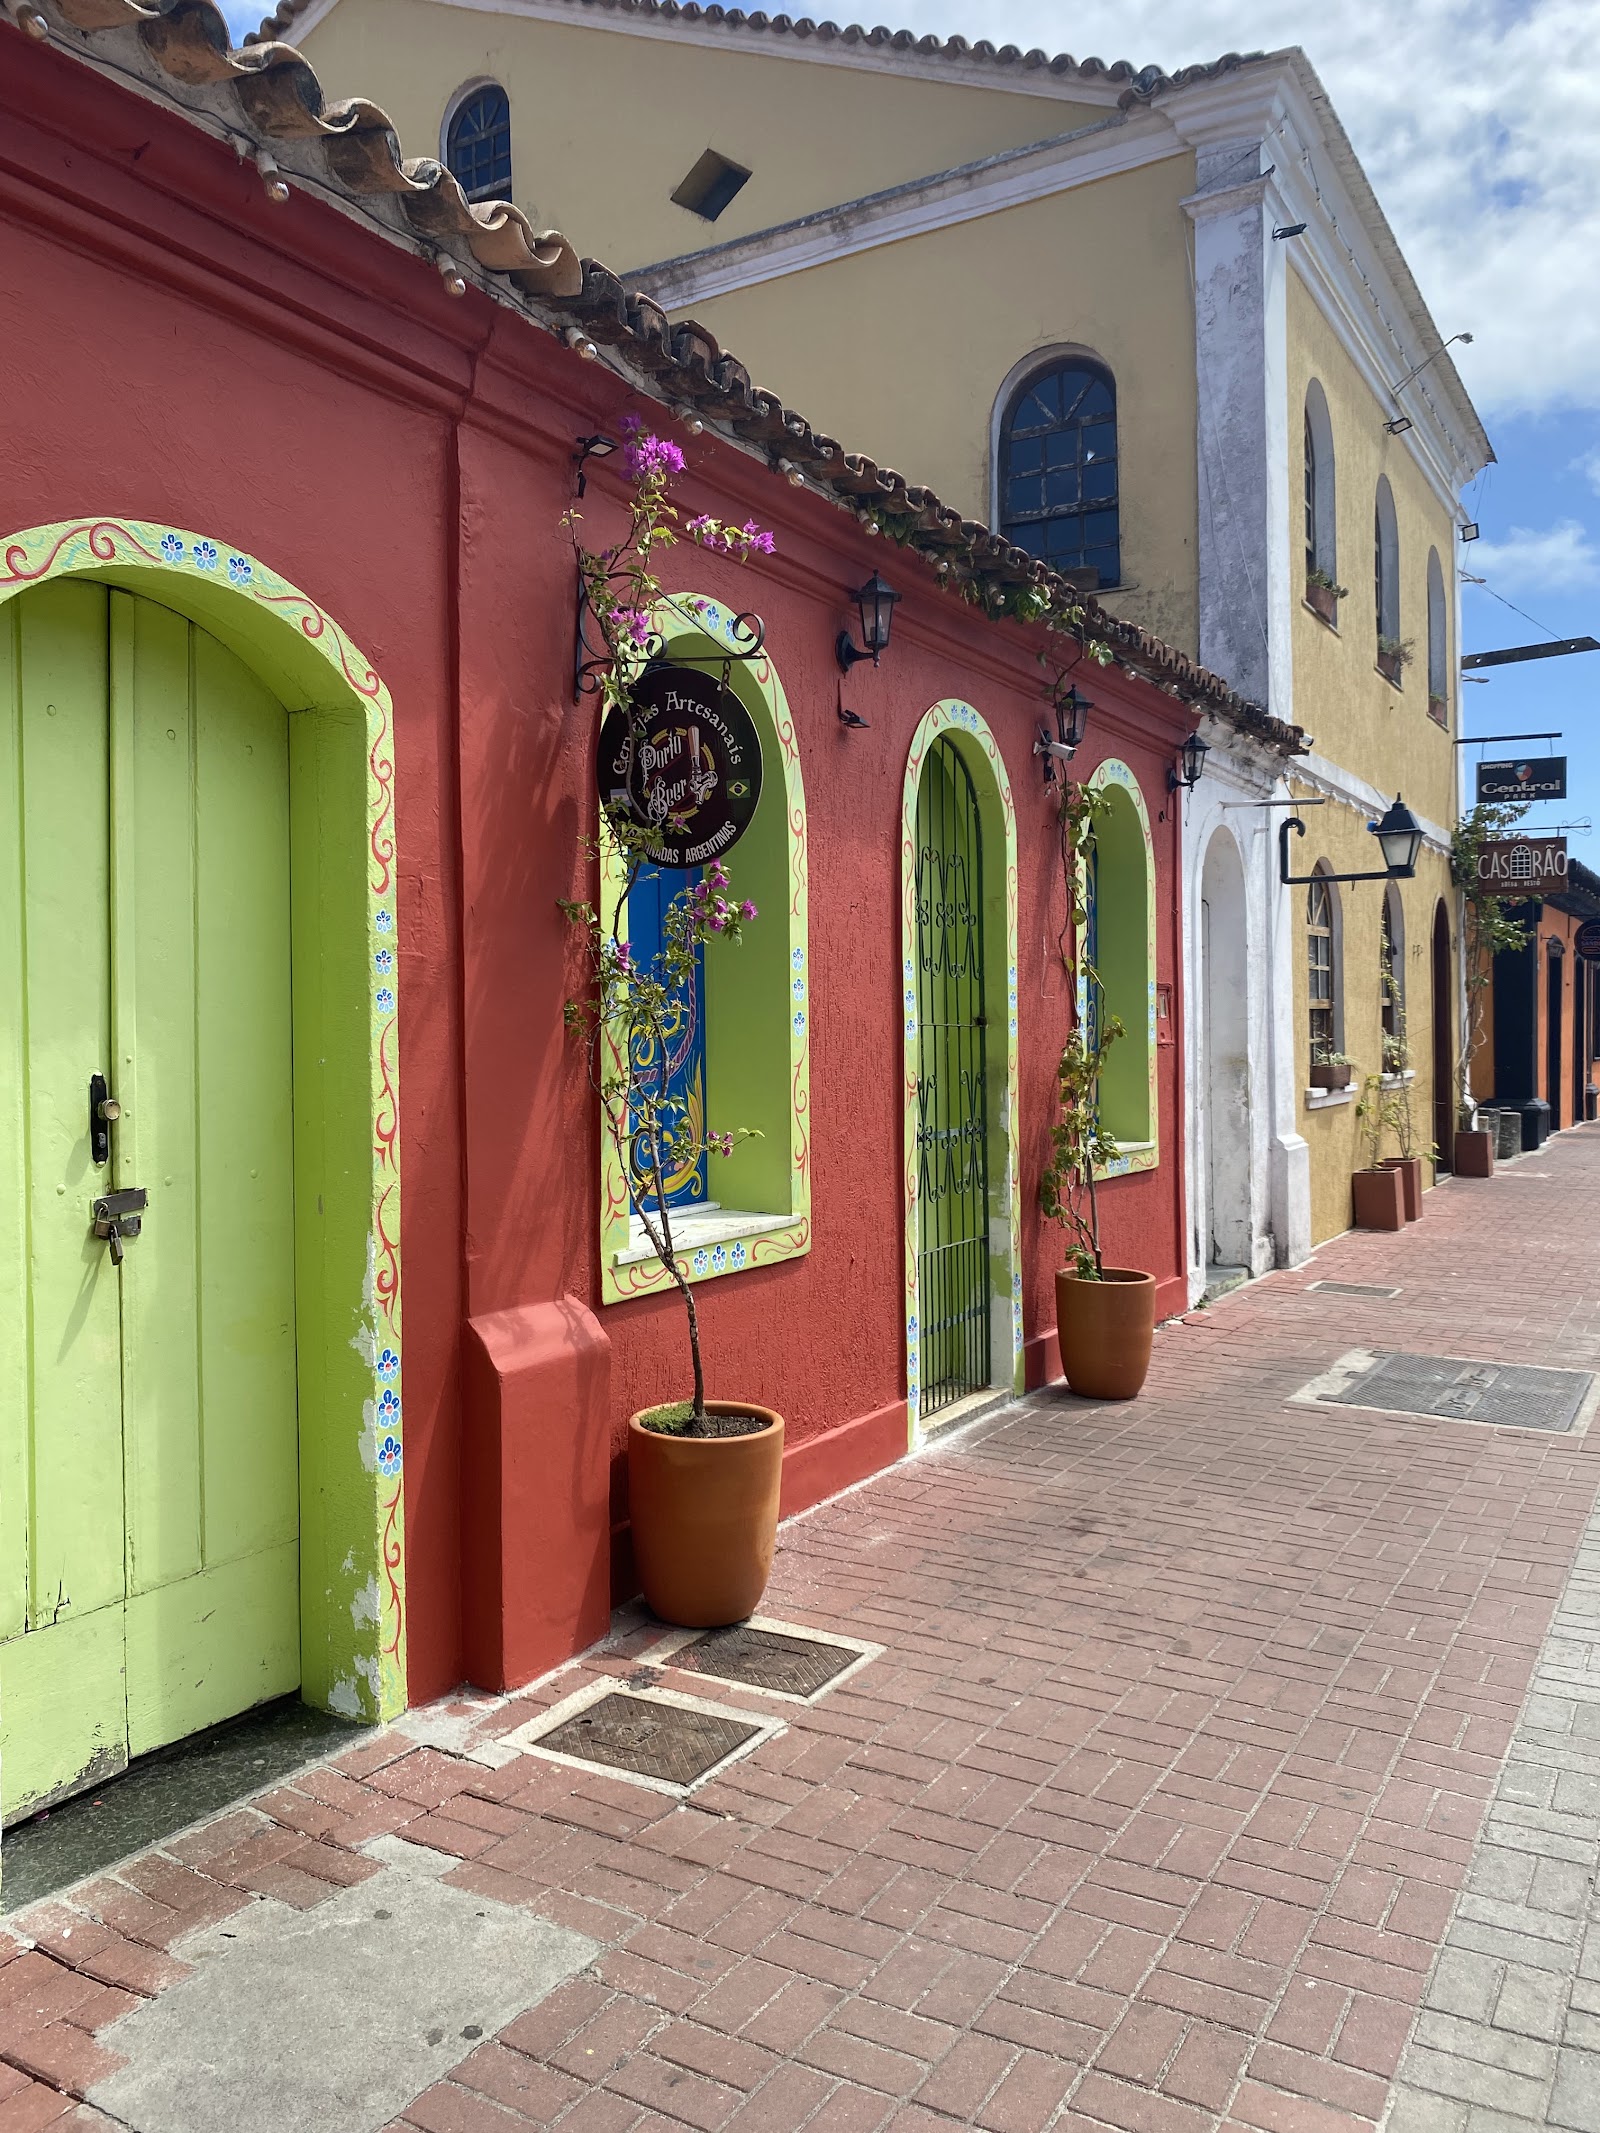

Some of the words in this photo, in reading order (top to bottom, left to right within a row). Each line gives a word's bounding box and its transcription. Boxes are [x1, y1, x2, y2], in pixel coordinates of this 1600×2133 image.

[665, 691, 743, 765] Artesanais
[638, 730, 682, 790] Porto
[648, 776, 687, 822] Beer
[1481, 780, 1561, 793] Central
[685, 820, 737, 864] ARGENTINAS
